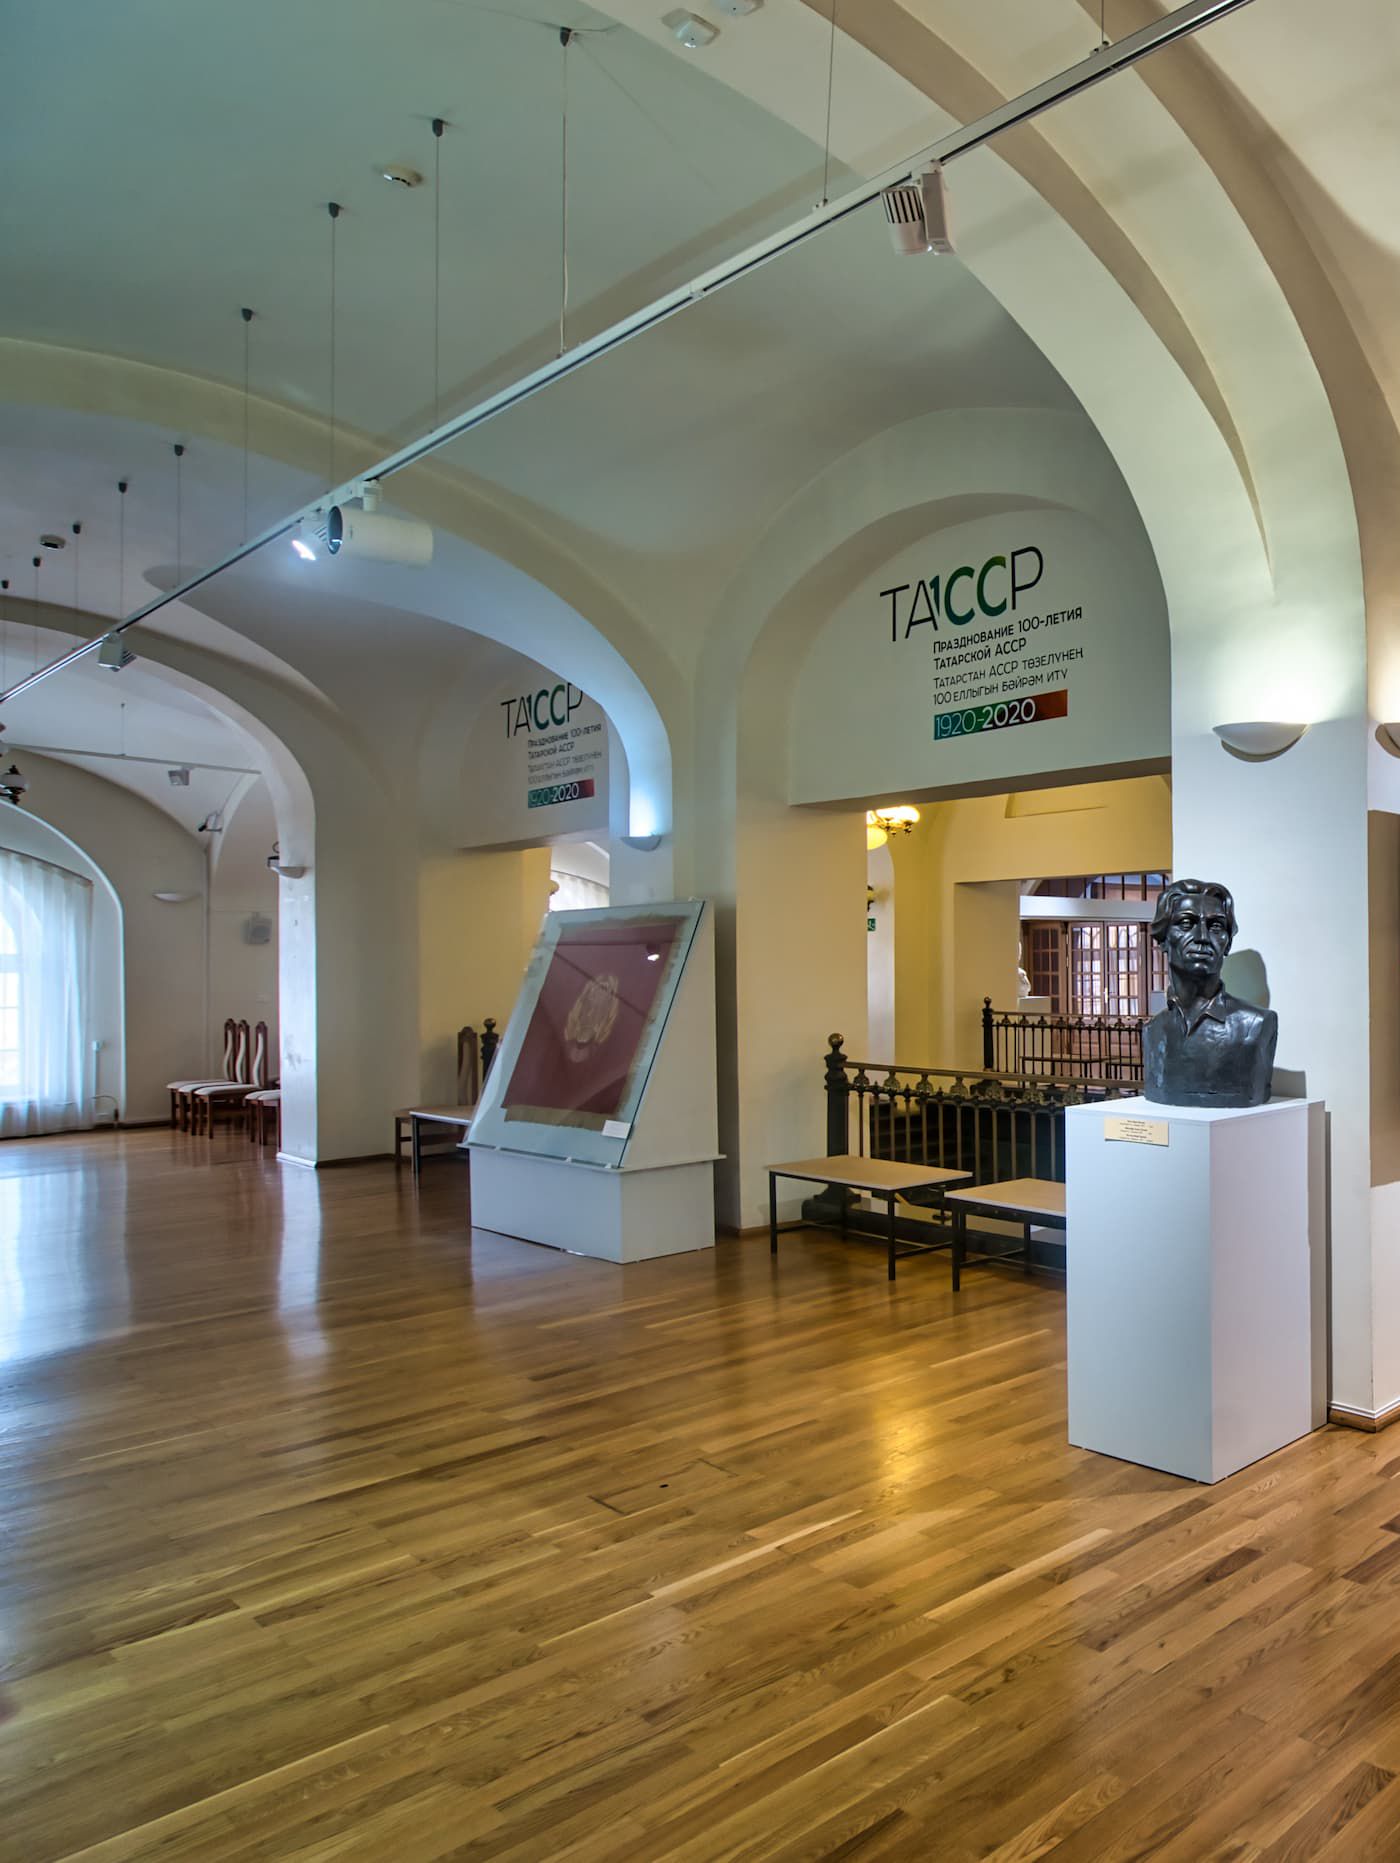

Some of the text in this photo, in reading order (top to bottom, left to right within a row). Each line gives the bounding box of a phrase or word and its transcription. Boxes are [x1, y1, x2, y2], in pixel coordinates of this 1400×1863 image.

[933, 606, 1083, 654] ПРАЗДНОВАНИЕ 100-ЛЕТИЯ
[933, 637, 1027, 670] ТАТАРСКОЙ АССР
[933, 670, 986, 689] ТАТАРСТАН
[989, 660, 1019, 678] АССР
[933, 691, 952, 706] 100
[936, 698, 1036, 737] 1920-2020
